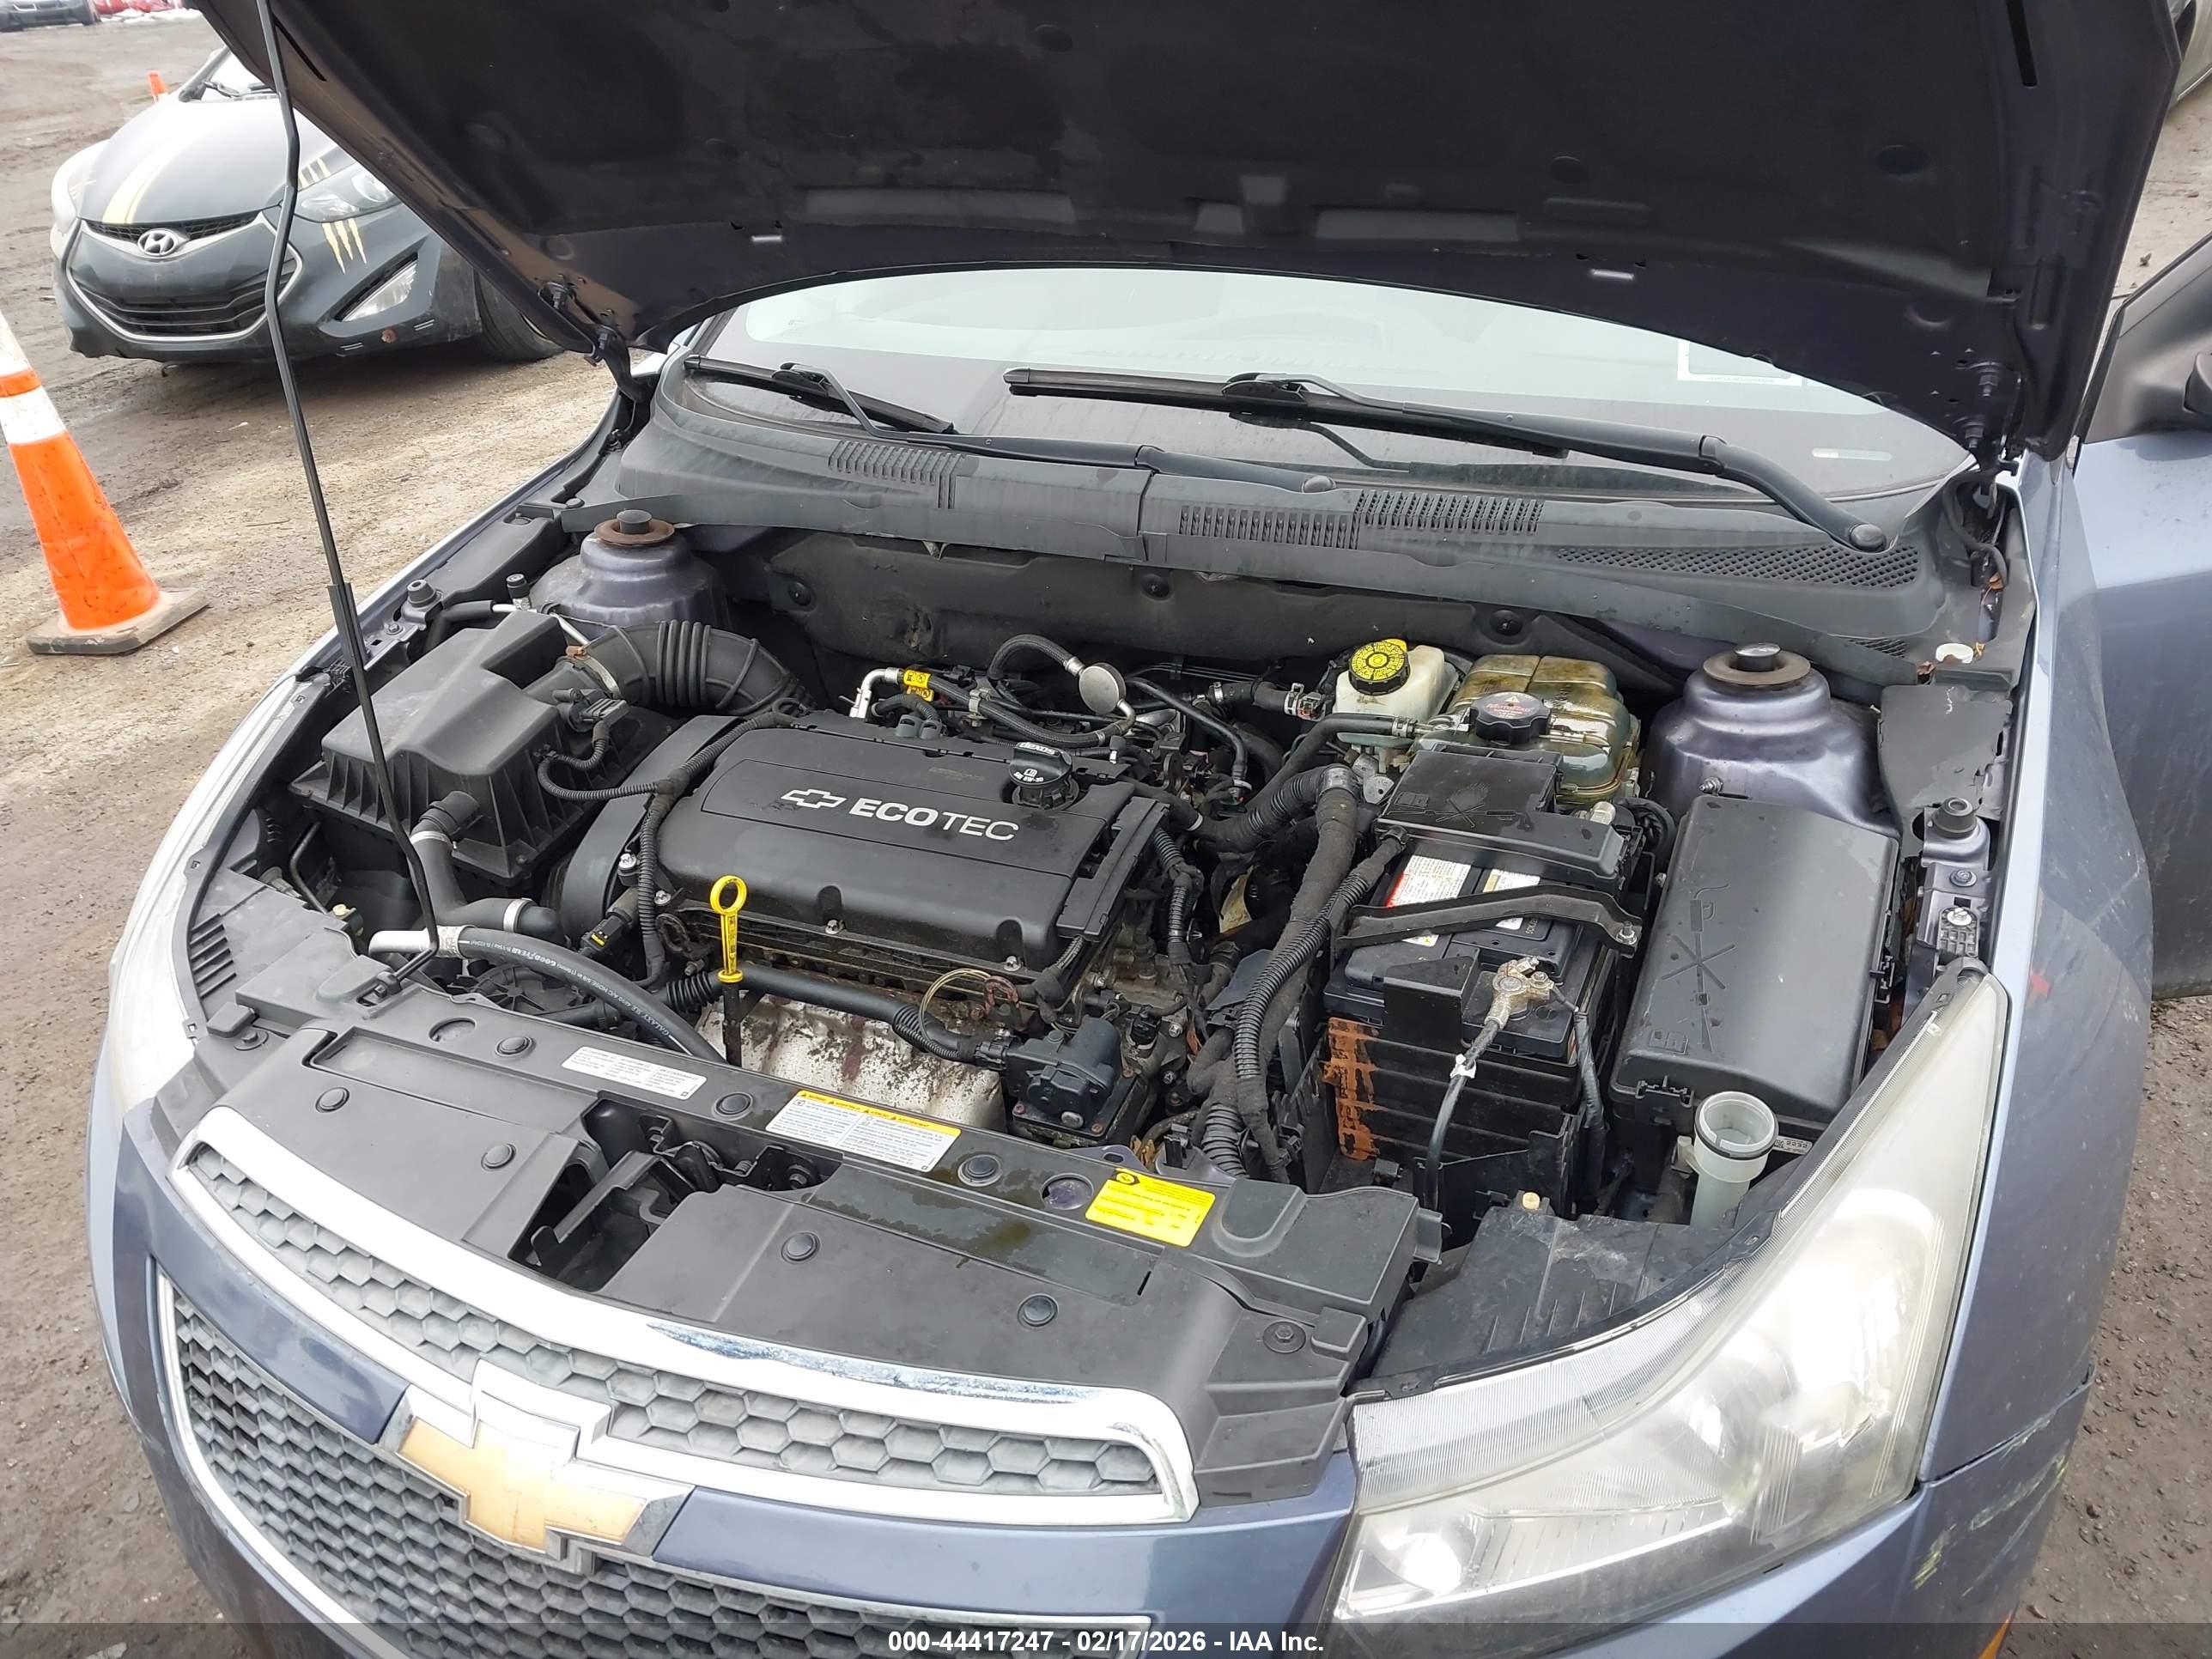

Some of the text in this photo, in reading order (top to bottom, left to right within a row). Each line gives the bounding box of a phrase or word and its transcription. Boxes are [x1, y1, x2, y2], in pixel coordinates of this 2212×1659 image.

[1018, 742, 1056, 755] dexos
[849, 798, 1019, 841] ECOTEC
[512, 947, 556, 967] GOODYEAR
[642, 1013, 670, 1036] GALAXY
